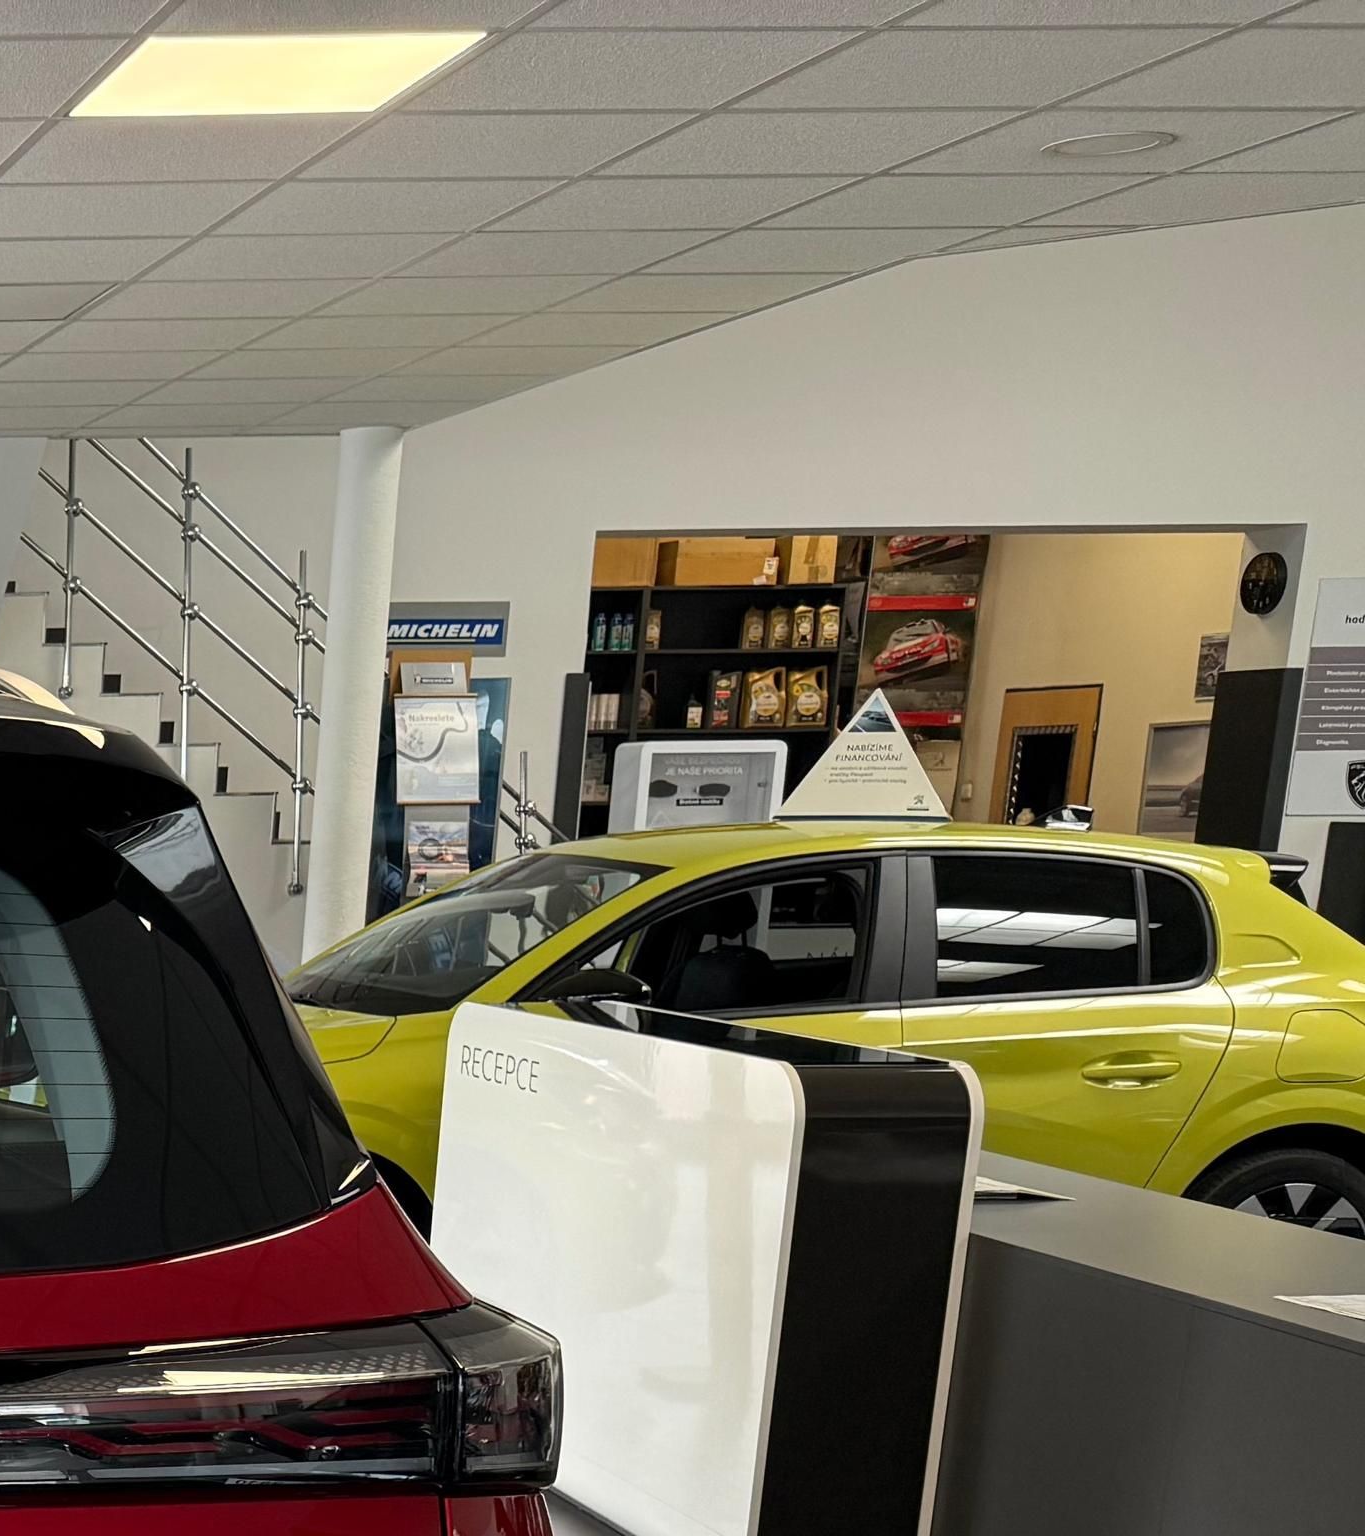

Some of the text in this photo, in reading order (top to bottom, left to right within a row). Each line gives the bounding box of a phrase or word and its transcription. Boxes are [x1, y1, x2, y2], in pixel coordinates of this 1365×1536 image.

[387, 624, 500, 638] MICHELIN
[846, 743, 894, 752] NABÍZÍME
[835, 753, 903, 762] FINANCOVÁNÍ
[461, 1045, 540, 1093] RECEPCE
